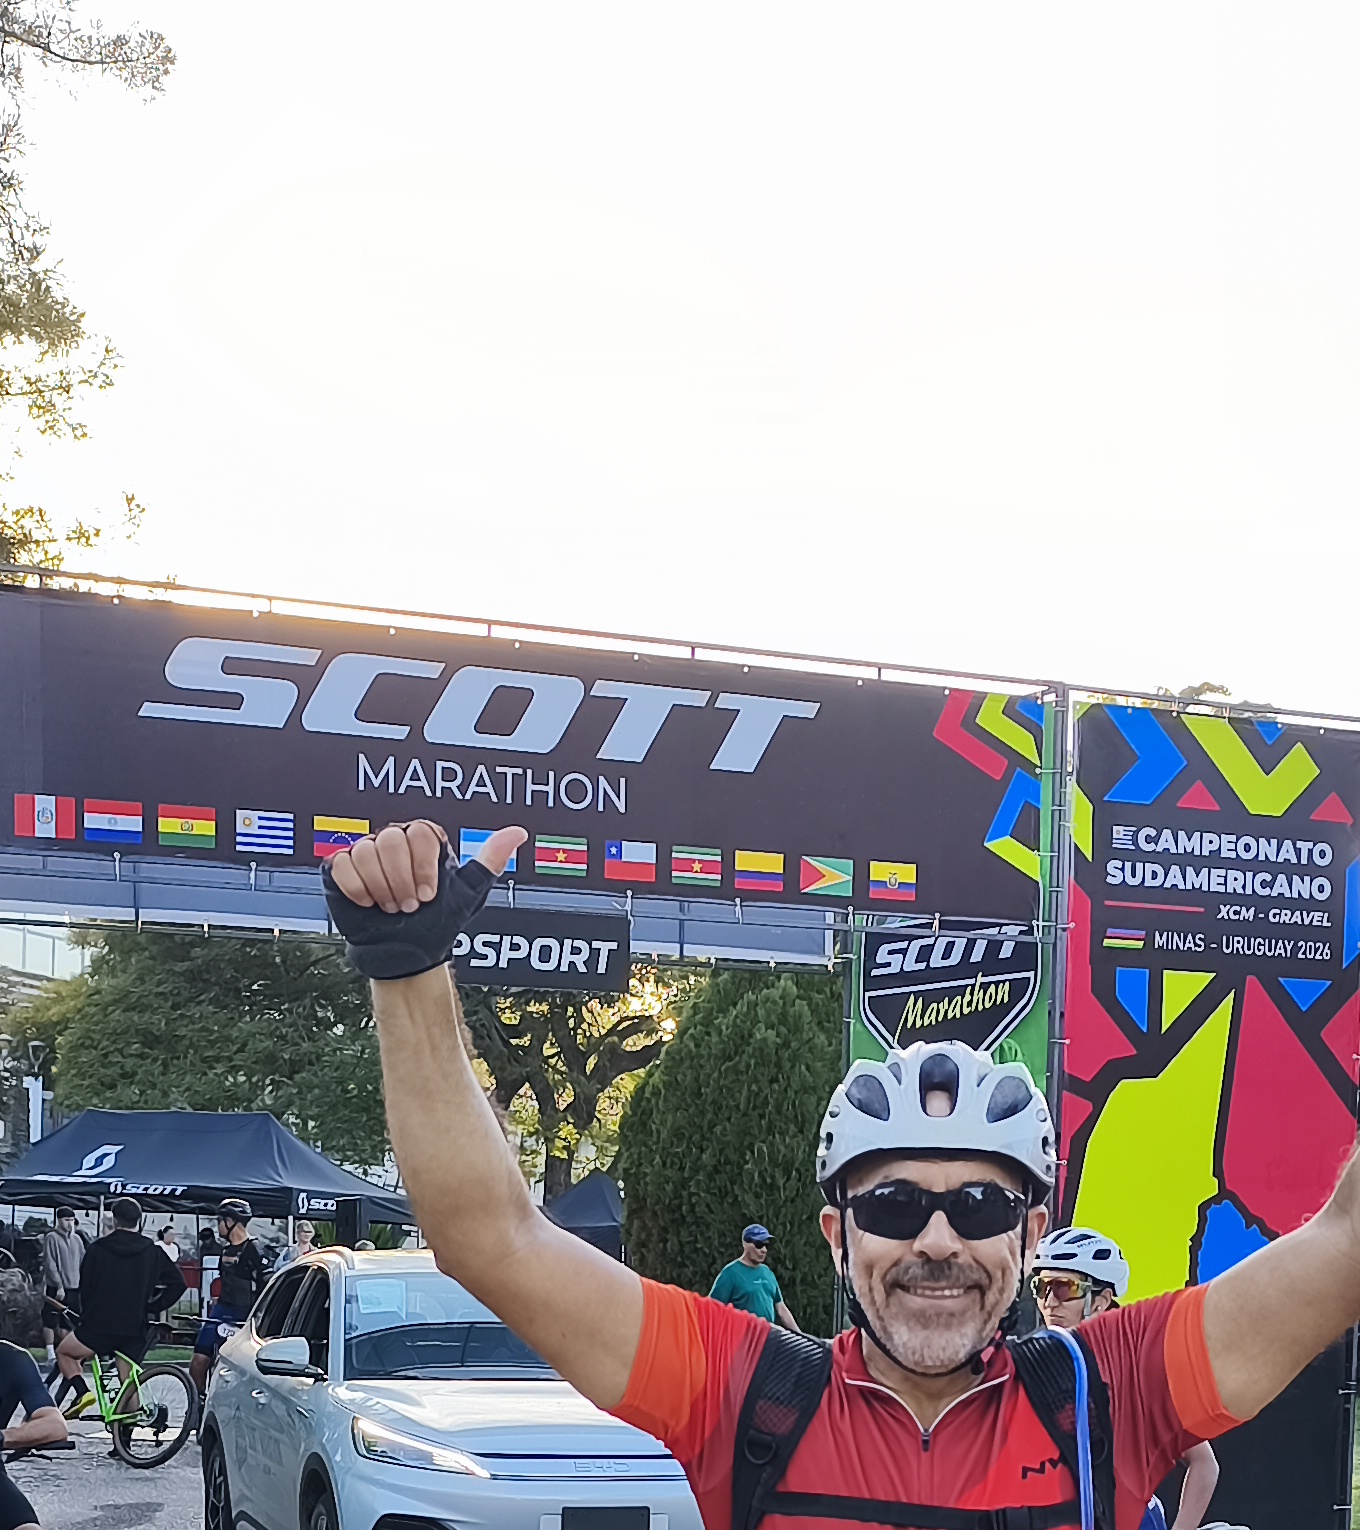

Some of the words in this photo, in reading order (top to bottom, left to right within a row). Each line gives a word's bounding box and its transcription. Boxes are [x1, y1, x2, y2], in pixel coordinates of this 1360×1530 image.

[137, 636, 820, 773] SCOTT
[357, 753, 629, 814] MARATHON
[1139, 826, 1333, 867] CAMPEONATO
[1105, 860, 1333, 901] SUDAMERICANO
[1216, 904, 1253, 921] XCM
[1268, 908, 1332, 927] GRAVEL
[452, 932, 619, 974] PSPORT
[1154, 931, 1205, 953] MINAS
[1221, 935, 1293, 958] URUGUAY
[1296, 938, 1332, 960] 2026
[893, 972, 1010, 1044] Marathon
[121, 1185, 188, 1196] SCOTT
[309, 1198, 337, 1211] SCO
